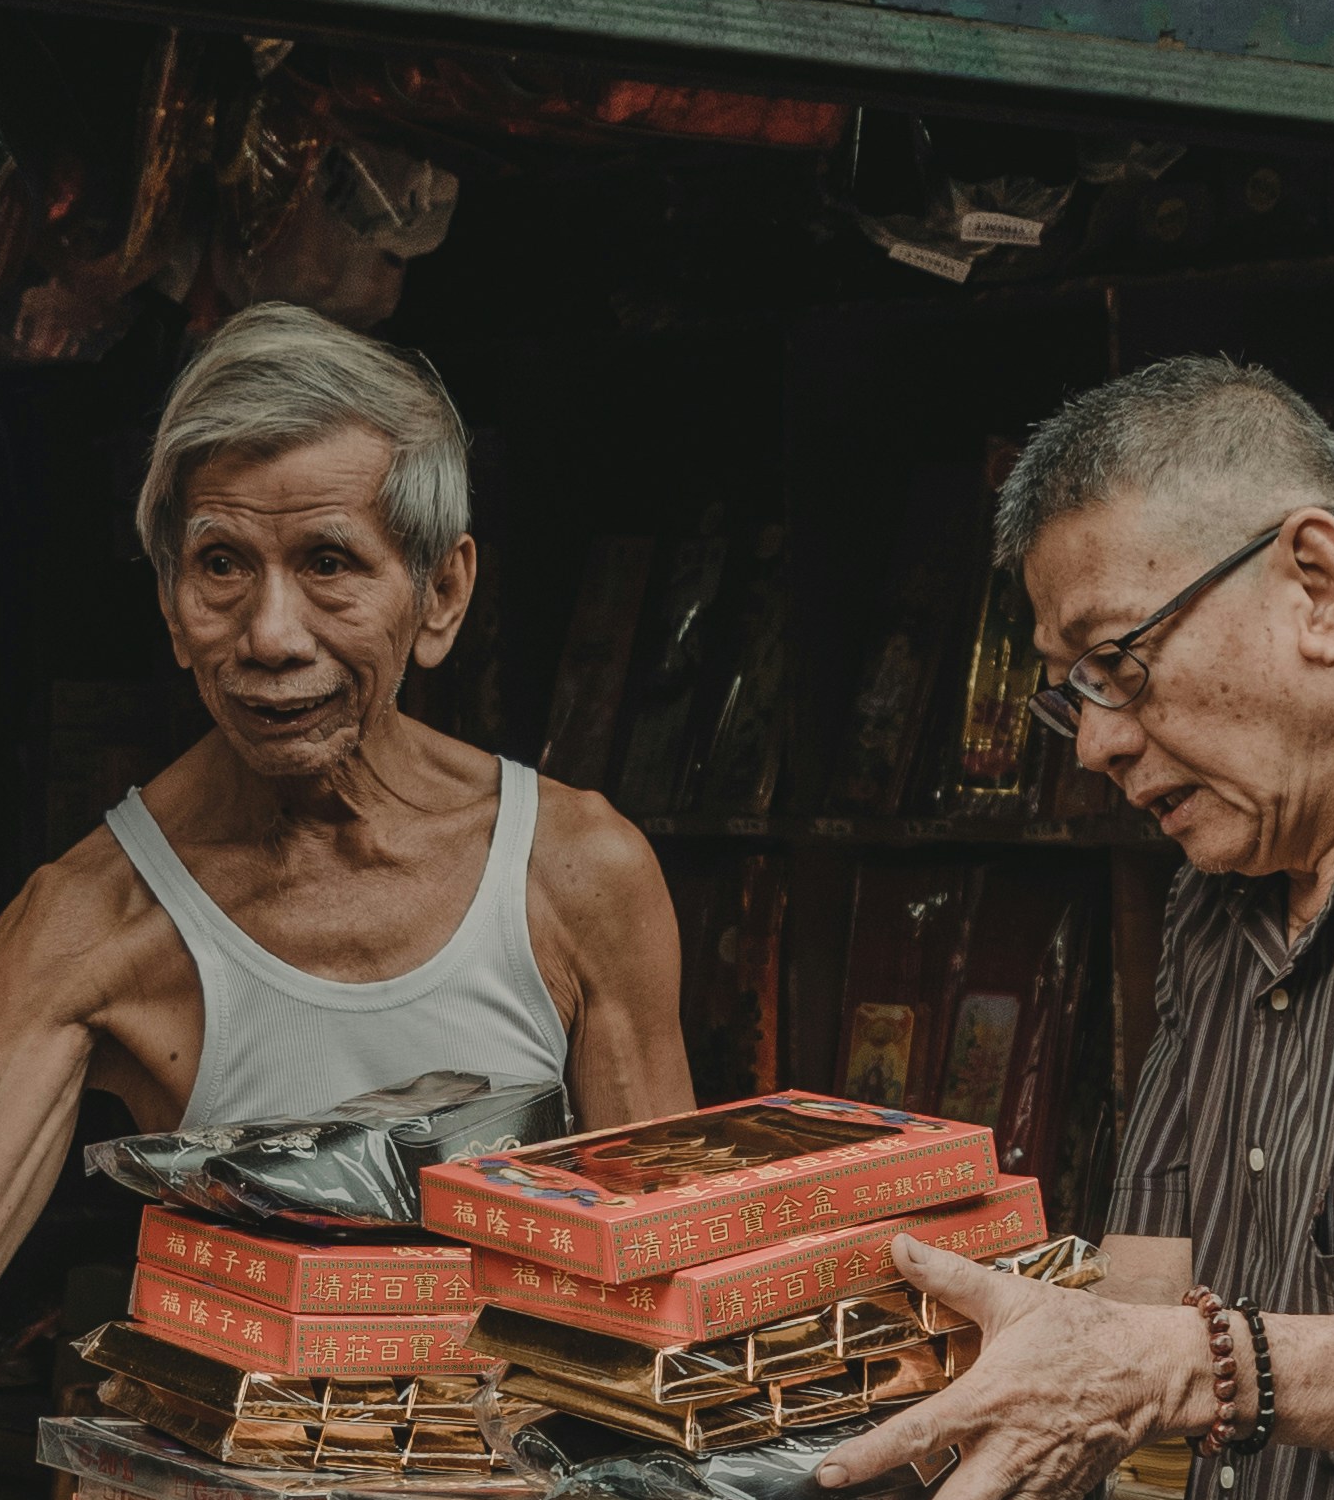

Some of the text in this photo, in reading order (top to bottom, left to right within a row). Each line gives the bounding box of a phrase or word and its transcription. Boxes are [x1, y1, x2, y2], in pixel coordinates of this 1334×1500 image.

[452, 1198, 576, 1255] 福蔭子孫
[625, 1184, 840, 1262] 精莊百寶金盒
[165, 1231, 268, 1284] 福蔭子孫
[511, 1260, 658, 1312] 福蔭子孫
[160, 1289, 264, 1345] 福蔭子孫
[304, 1333, 496, 1364] 精莊百寶金
